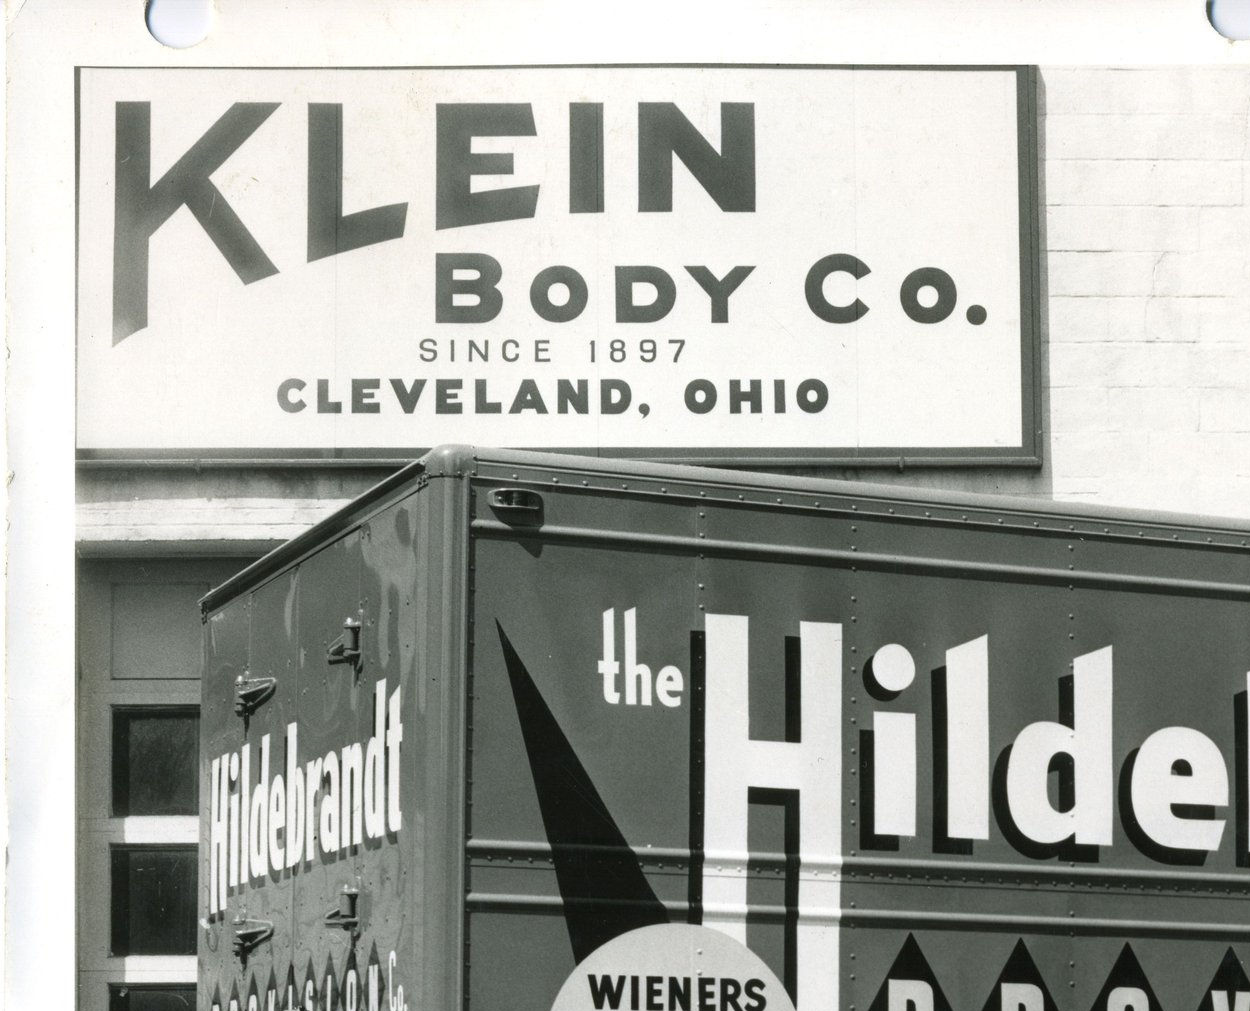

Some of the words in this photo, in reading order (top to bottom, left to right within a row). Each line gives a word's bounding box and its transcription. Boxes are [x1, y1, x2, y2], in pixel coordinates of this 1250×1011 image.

[112, 101, 757, 349] KLEIN
[435, 252, 757, 325] BODY
[418, 339, 552, 364] SINCE
[589, 339, 687, 364] 1897
[276, 378, 651, 419] CLEVELAND,
[684, 378, 830, 415] OHIO
[597, 607, 684, 708] the
[209, 678, 403, 914] Hildebrandt
